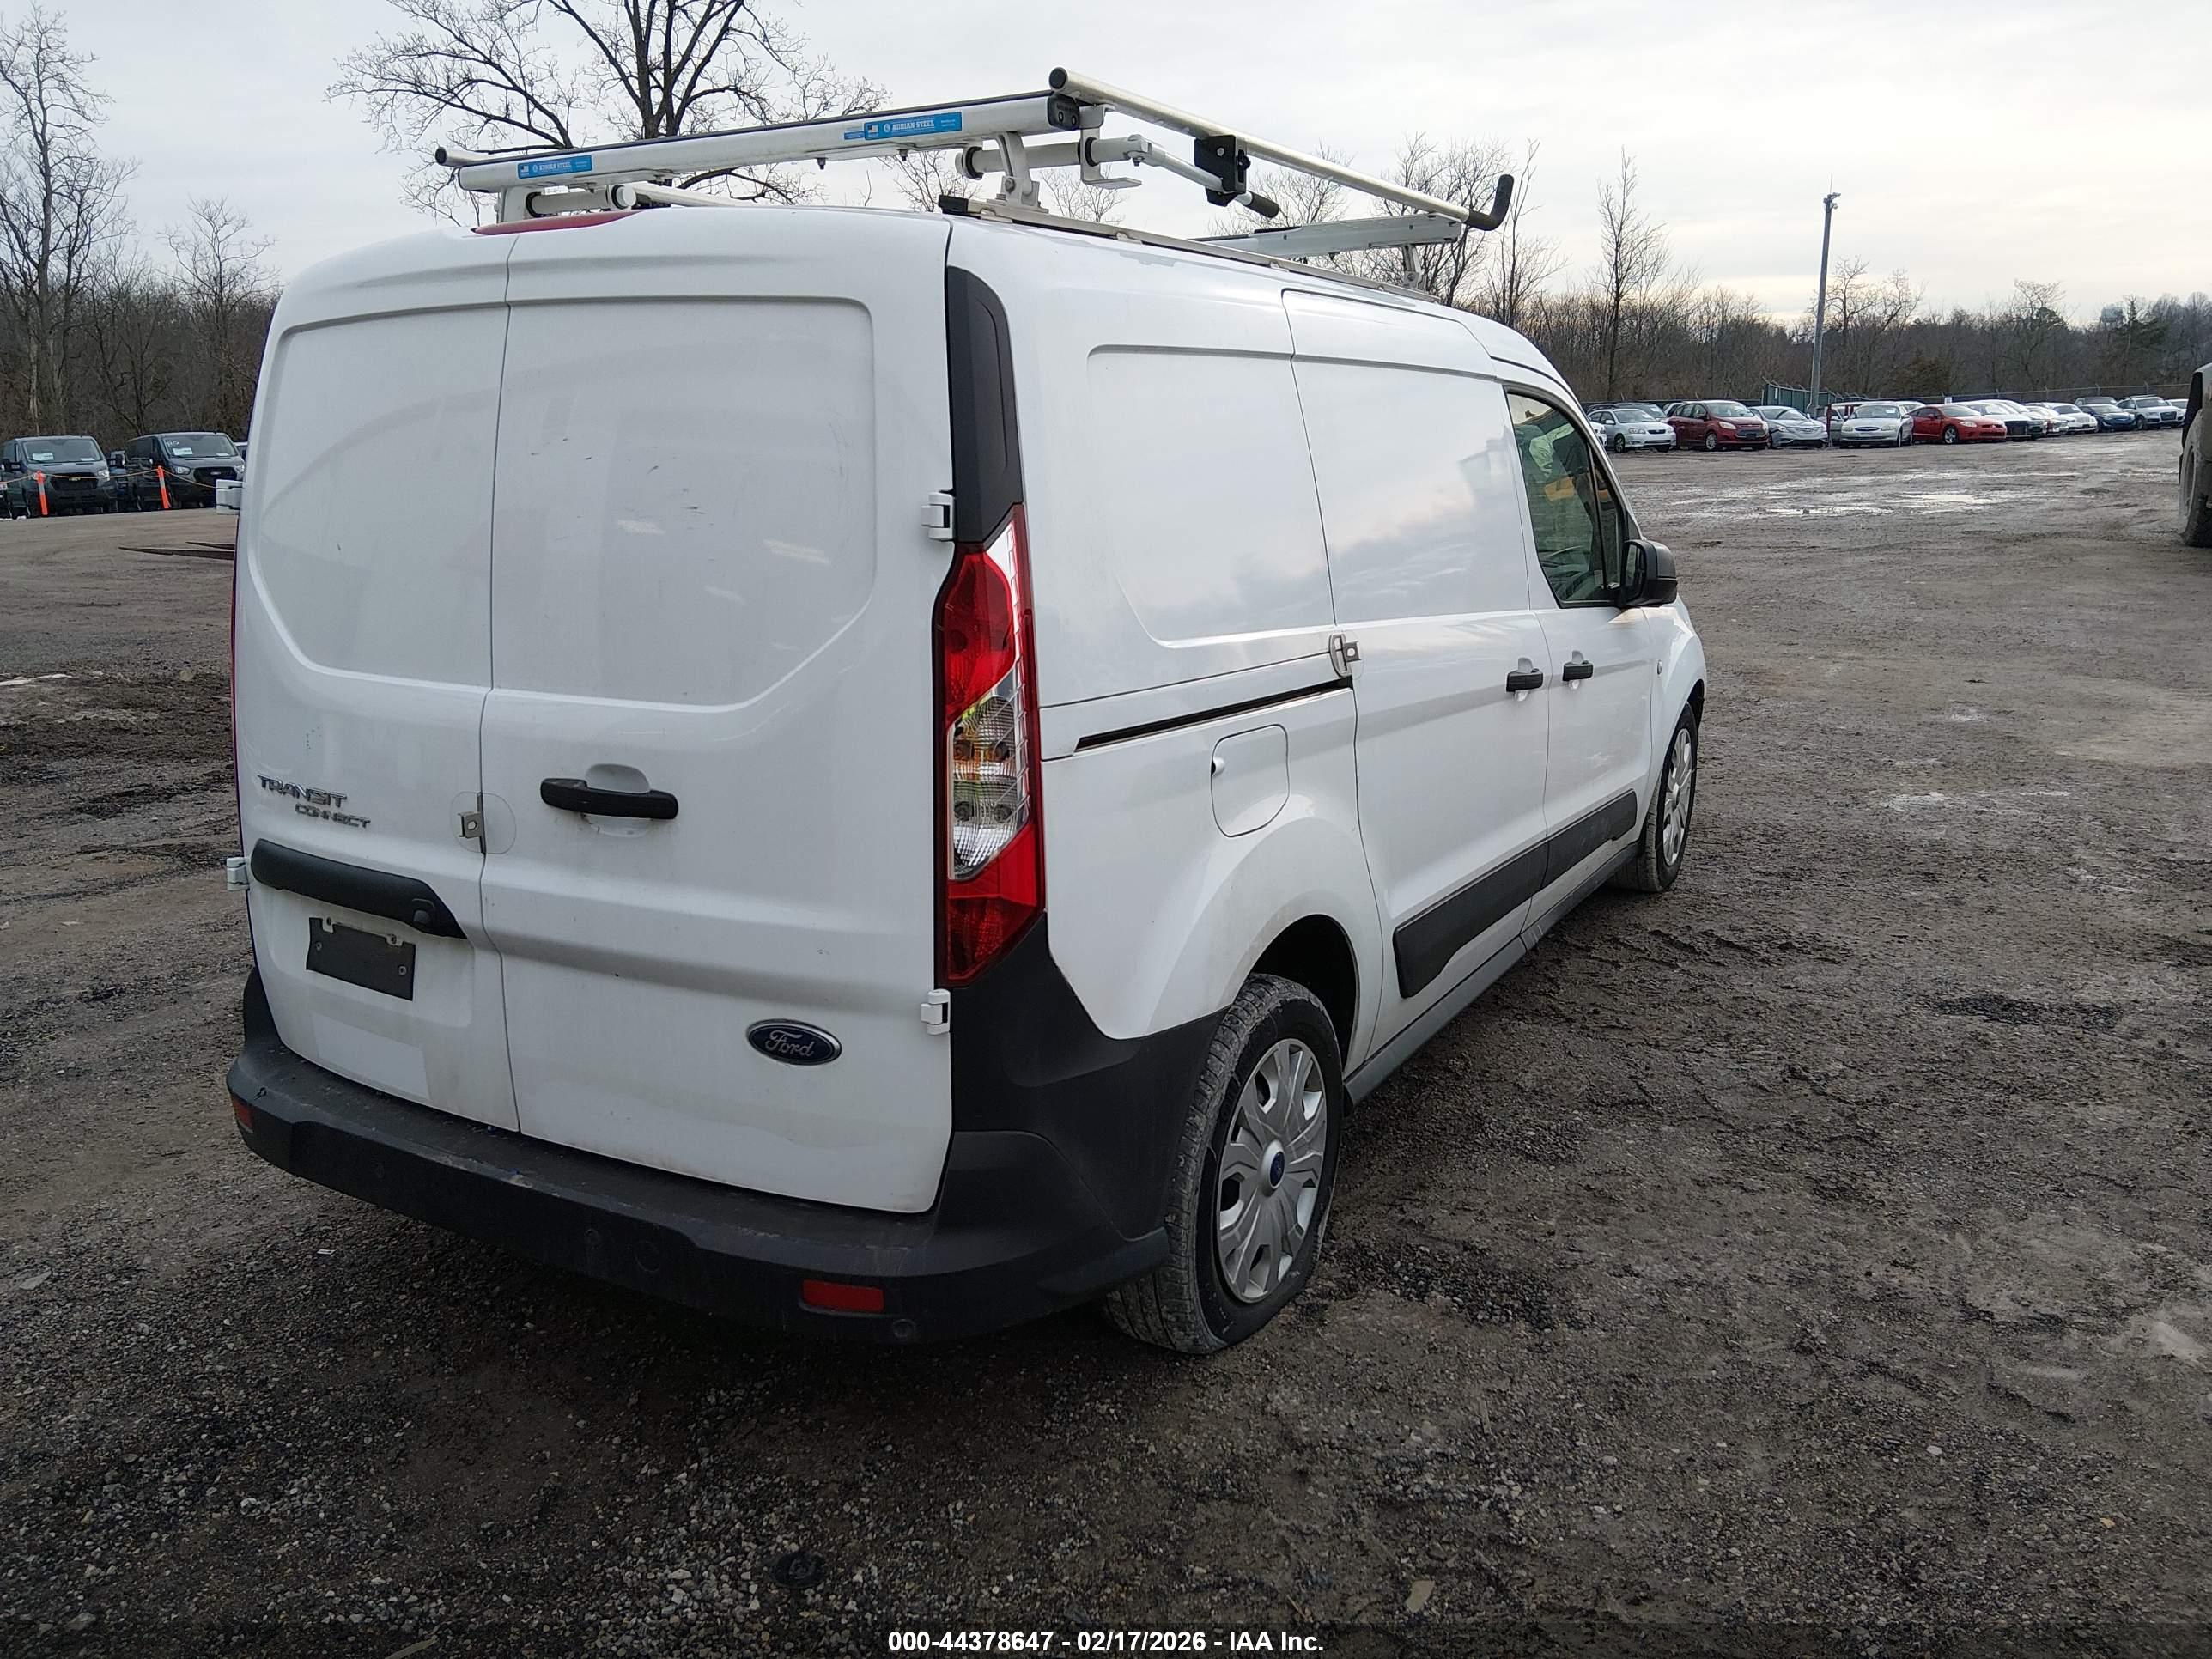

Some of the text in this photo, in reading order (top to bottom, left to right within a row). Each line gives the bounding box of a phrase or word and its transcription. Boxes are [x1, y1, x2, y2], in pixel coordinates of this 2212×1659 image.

[915, 119, 935, 130] STEEL
[258, 774, 347, 808] TRANSIT
[295, 803, 371, 829] CONNECT
[765, 1030, 815, 1057] Ford
